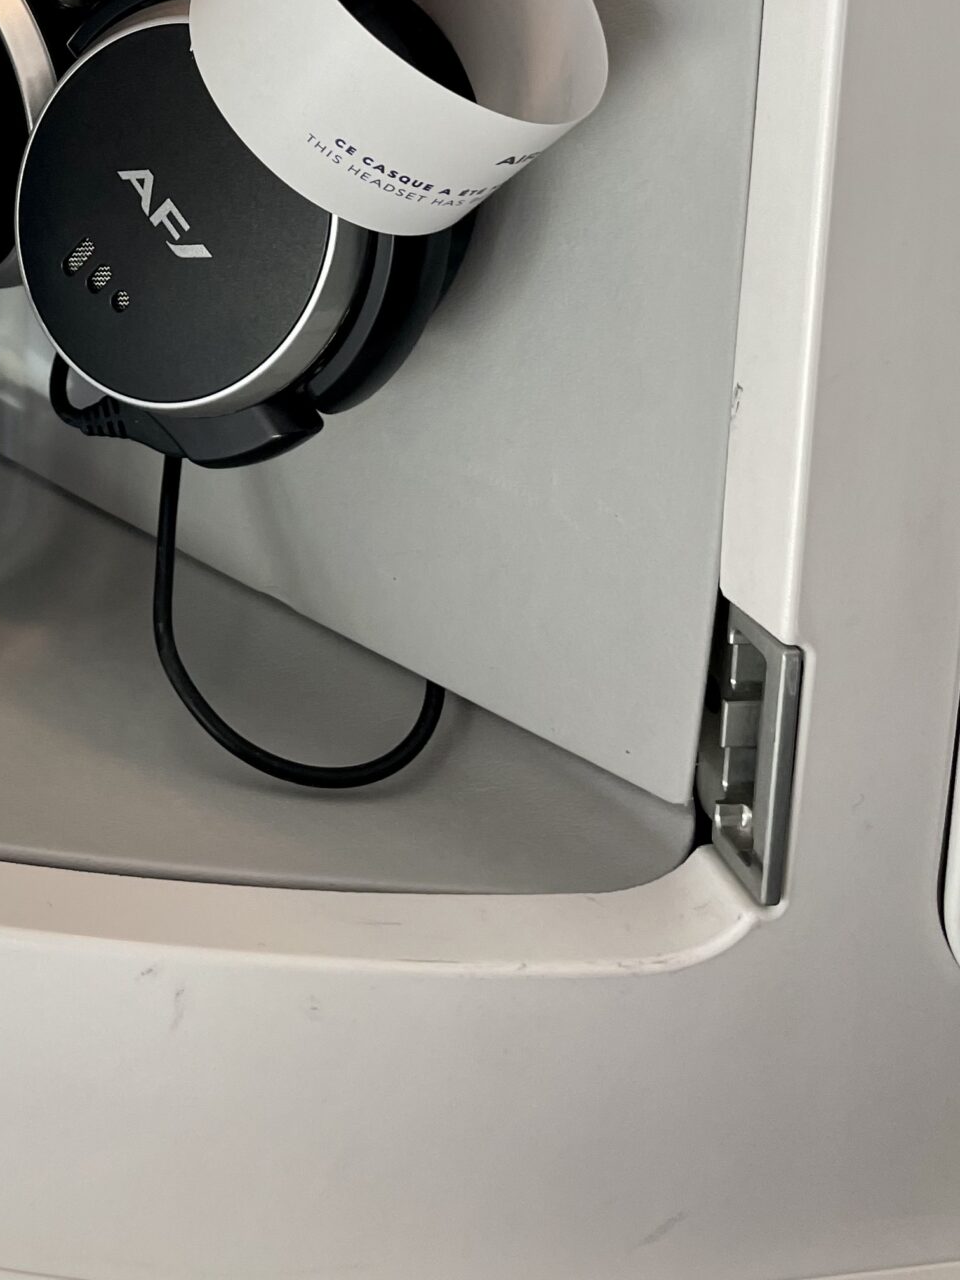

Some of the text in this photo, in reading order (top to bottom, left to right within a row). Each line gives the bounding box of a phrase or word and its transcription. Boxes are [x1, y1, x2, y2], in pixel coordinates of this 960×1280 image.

[305, 132, 342, 165] THIS
[346, 163, 425, 203] HEADSET
[334, 137, 358, 157] CE
[361, 155, 434, 192] CASQUE
[438, 188, 451, 196] A
